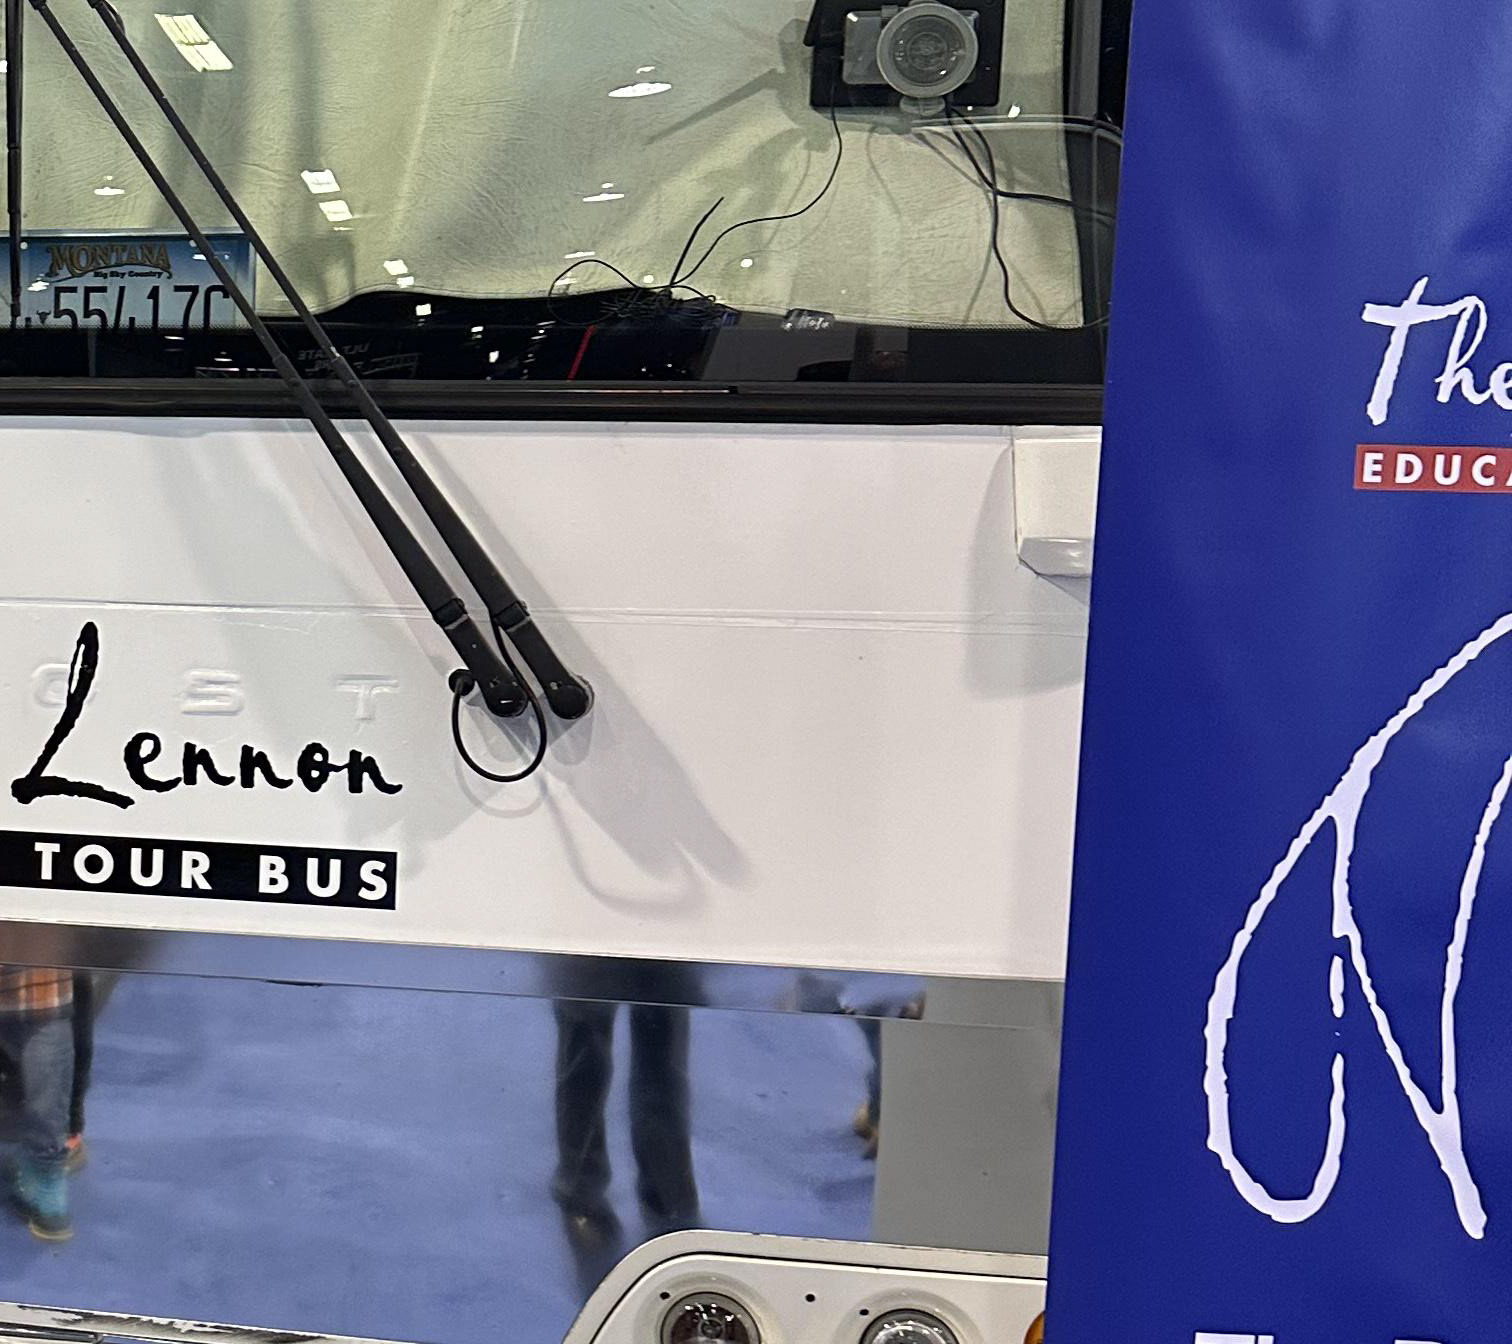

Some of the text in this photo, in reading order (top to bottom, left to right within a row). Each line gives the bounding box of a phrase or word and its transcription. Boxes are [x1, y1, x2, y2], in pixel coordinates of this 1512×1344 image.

[46, 242, 172, 277] MONTANA
[1363, 452, 1512, 487] EDUC
[11, 621, 403, 809] Lennon
[34, 841, 213, 890] TOUR
[258, 854, 389, 901] BUS
